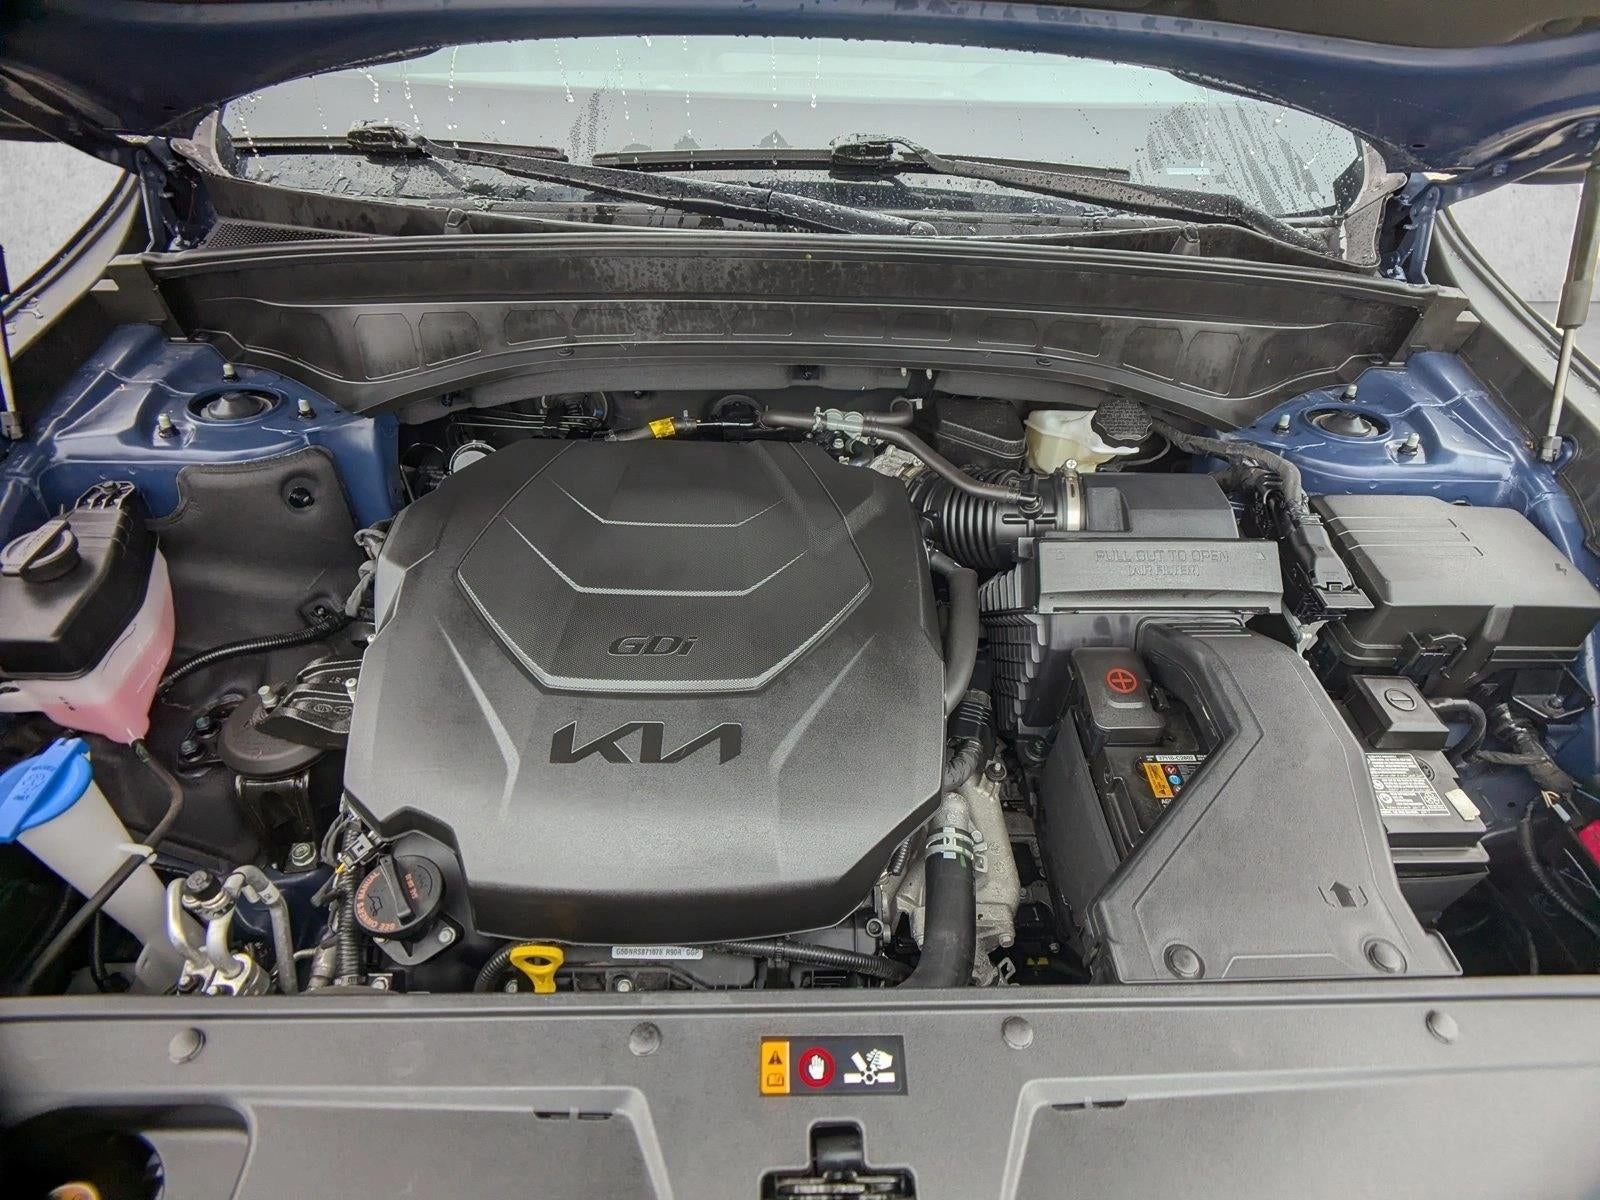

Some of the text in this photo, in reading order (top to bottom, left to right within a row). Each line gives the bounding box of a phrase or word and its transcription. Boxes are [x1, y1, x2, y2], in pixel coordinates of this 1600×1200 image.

[1095, 550, 1230, 563] PULL OUT TO OPEN
[607, 636, 697, 657] GDi
[549, 720, 742, 765] KIA
[357, 871, 381, 903] MANUAL
[378, 922, 396, 933] SEE
